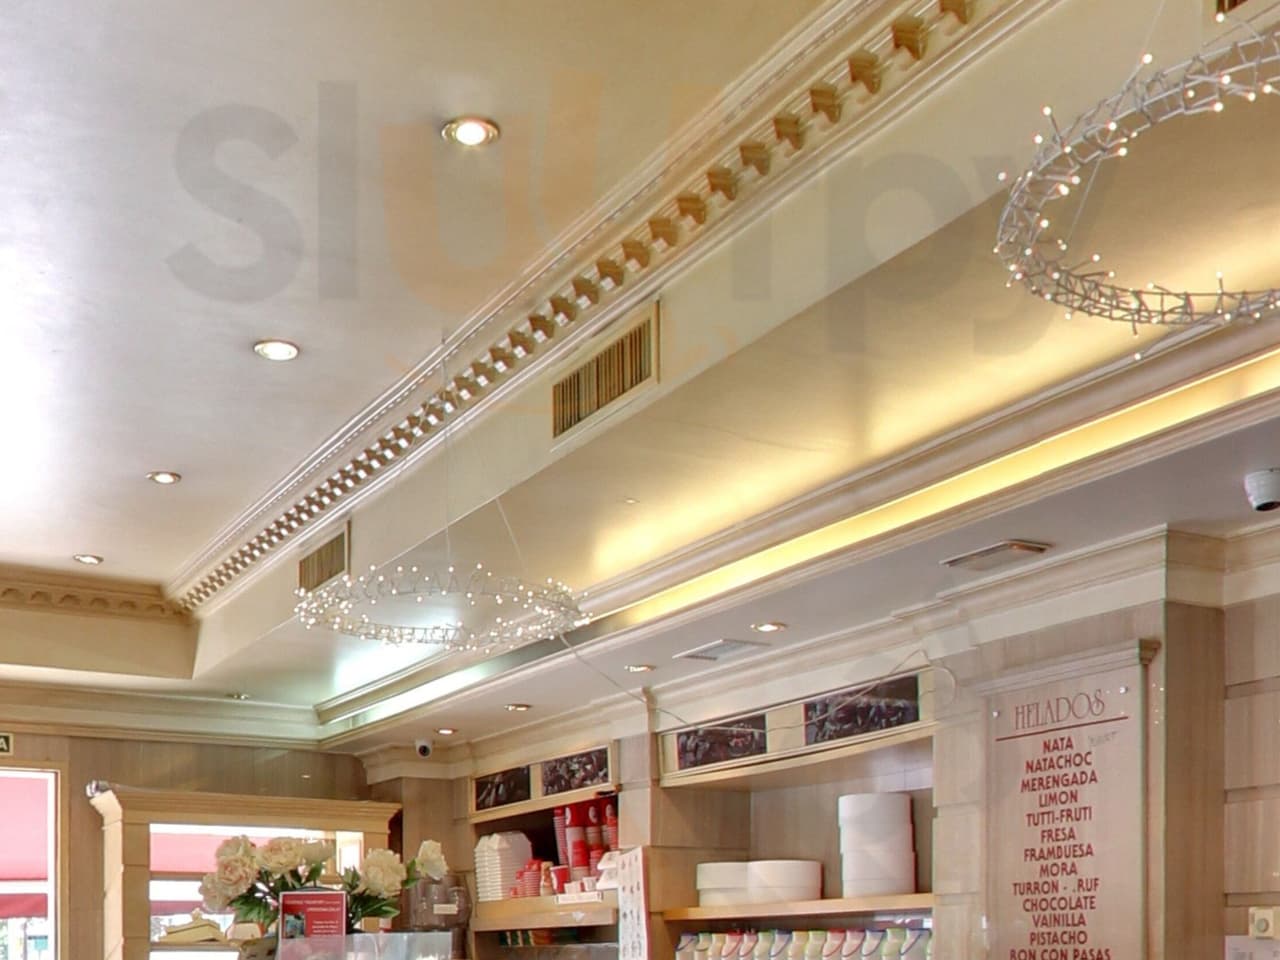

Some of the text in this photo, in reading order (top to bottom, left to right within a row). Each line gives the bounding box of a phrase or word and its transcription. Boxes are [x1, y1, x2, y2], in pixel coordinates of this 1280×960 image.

[1015, 689, 1105, 730] HELADOS
[1042, 736, 1074, 754] NATA
[1025, 751, 1092, 774] NATACHOC
[1021, 770, 1098, 793] MERENGADA
[1038, 790, 1078, 808] LIMON
[1026, 806, 1092, 827] TUTTI-FRUTI
[1040, 827, 1076, 843] FRESA
[1039, 861, 1078, 878] MORA
[1013, 880, 1060, 896] TURRON
[1022, 895, 1096, 912] CHOCOLATE
[1032, 912, 1087, 928] VAINILLA
[1030, 930, 1088, 946] PISTACHO
